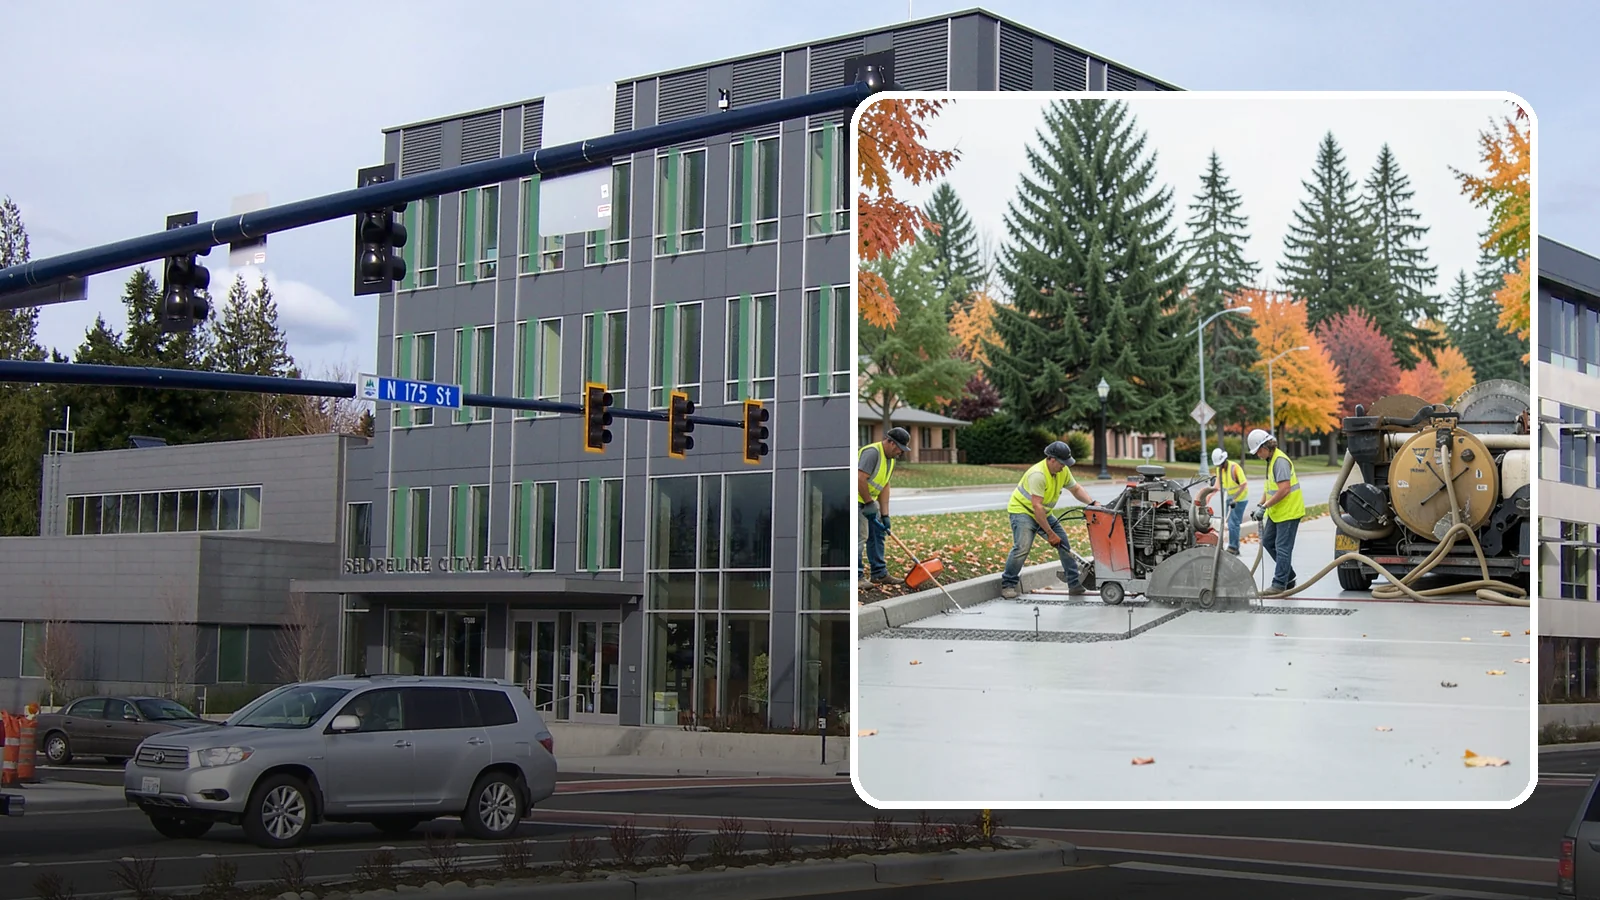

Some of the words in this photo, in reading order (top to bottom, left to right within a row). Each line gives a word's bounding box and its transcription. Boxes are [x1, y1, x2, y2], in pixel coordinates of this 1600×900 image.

[387, 381, 396, 399] N
[405, 382, 427, 403] 175
[436, 387, 451, 406] St
[344, 557, 431, 573] SHORELINE
[438, 556, 475, 572] CITY
[484, 555, 525, 571] HALL
